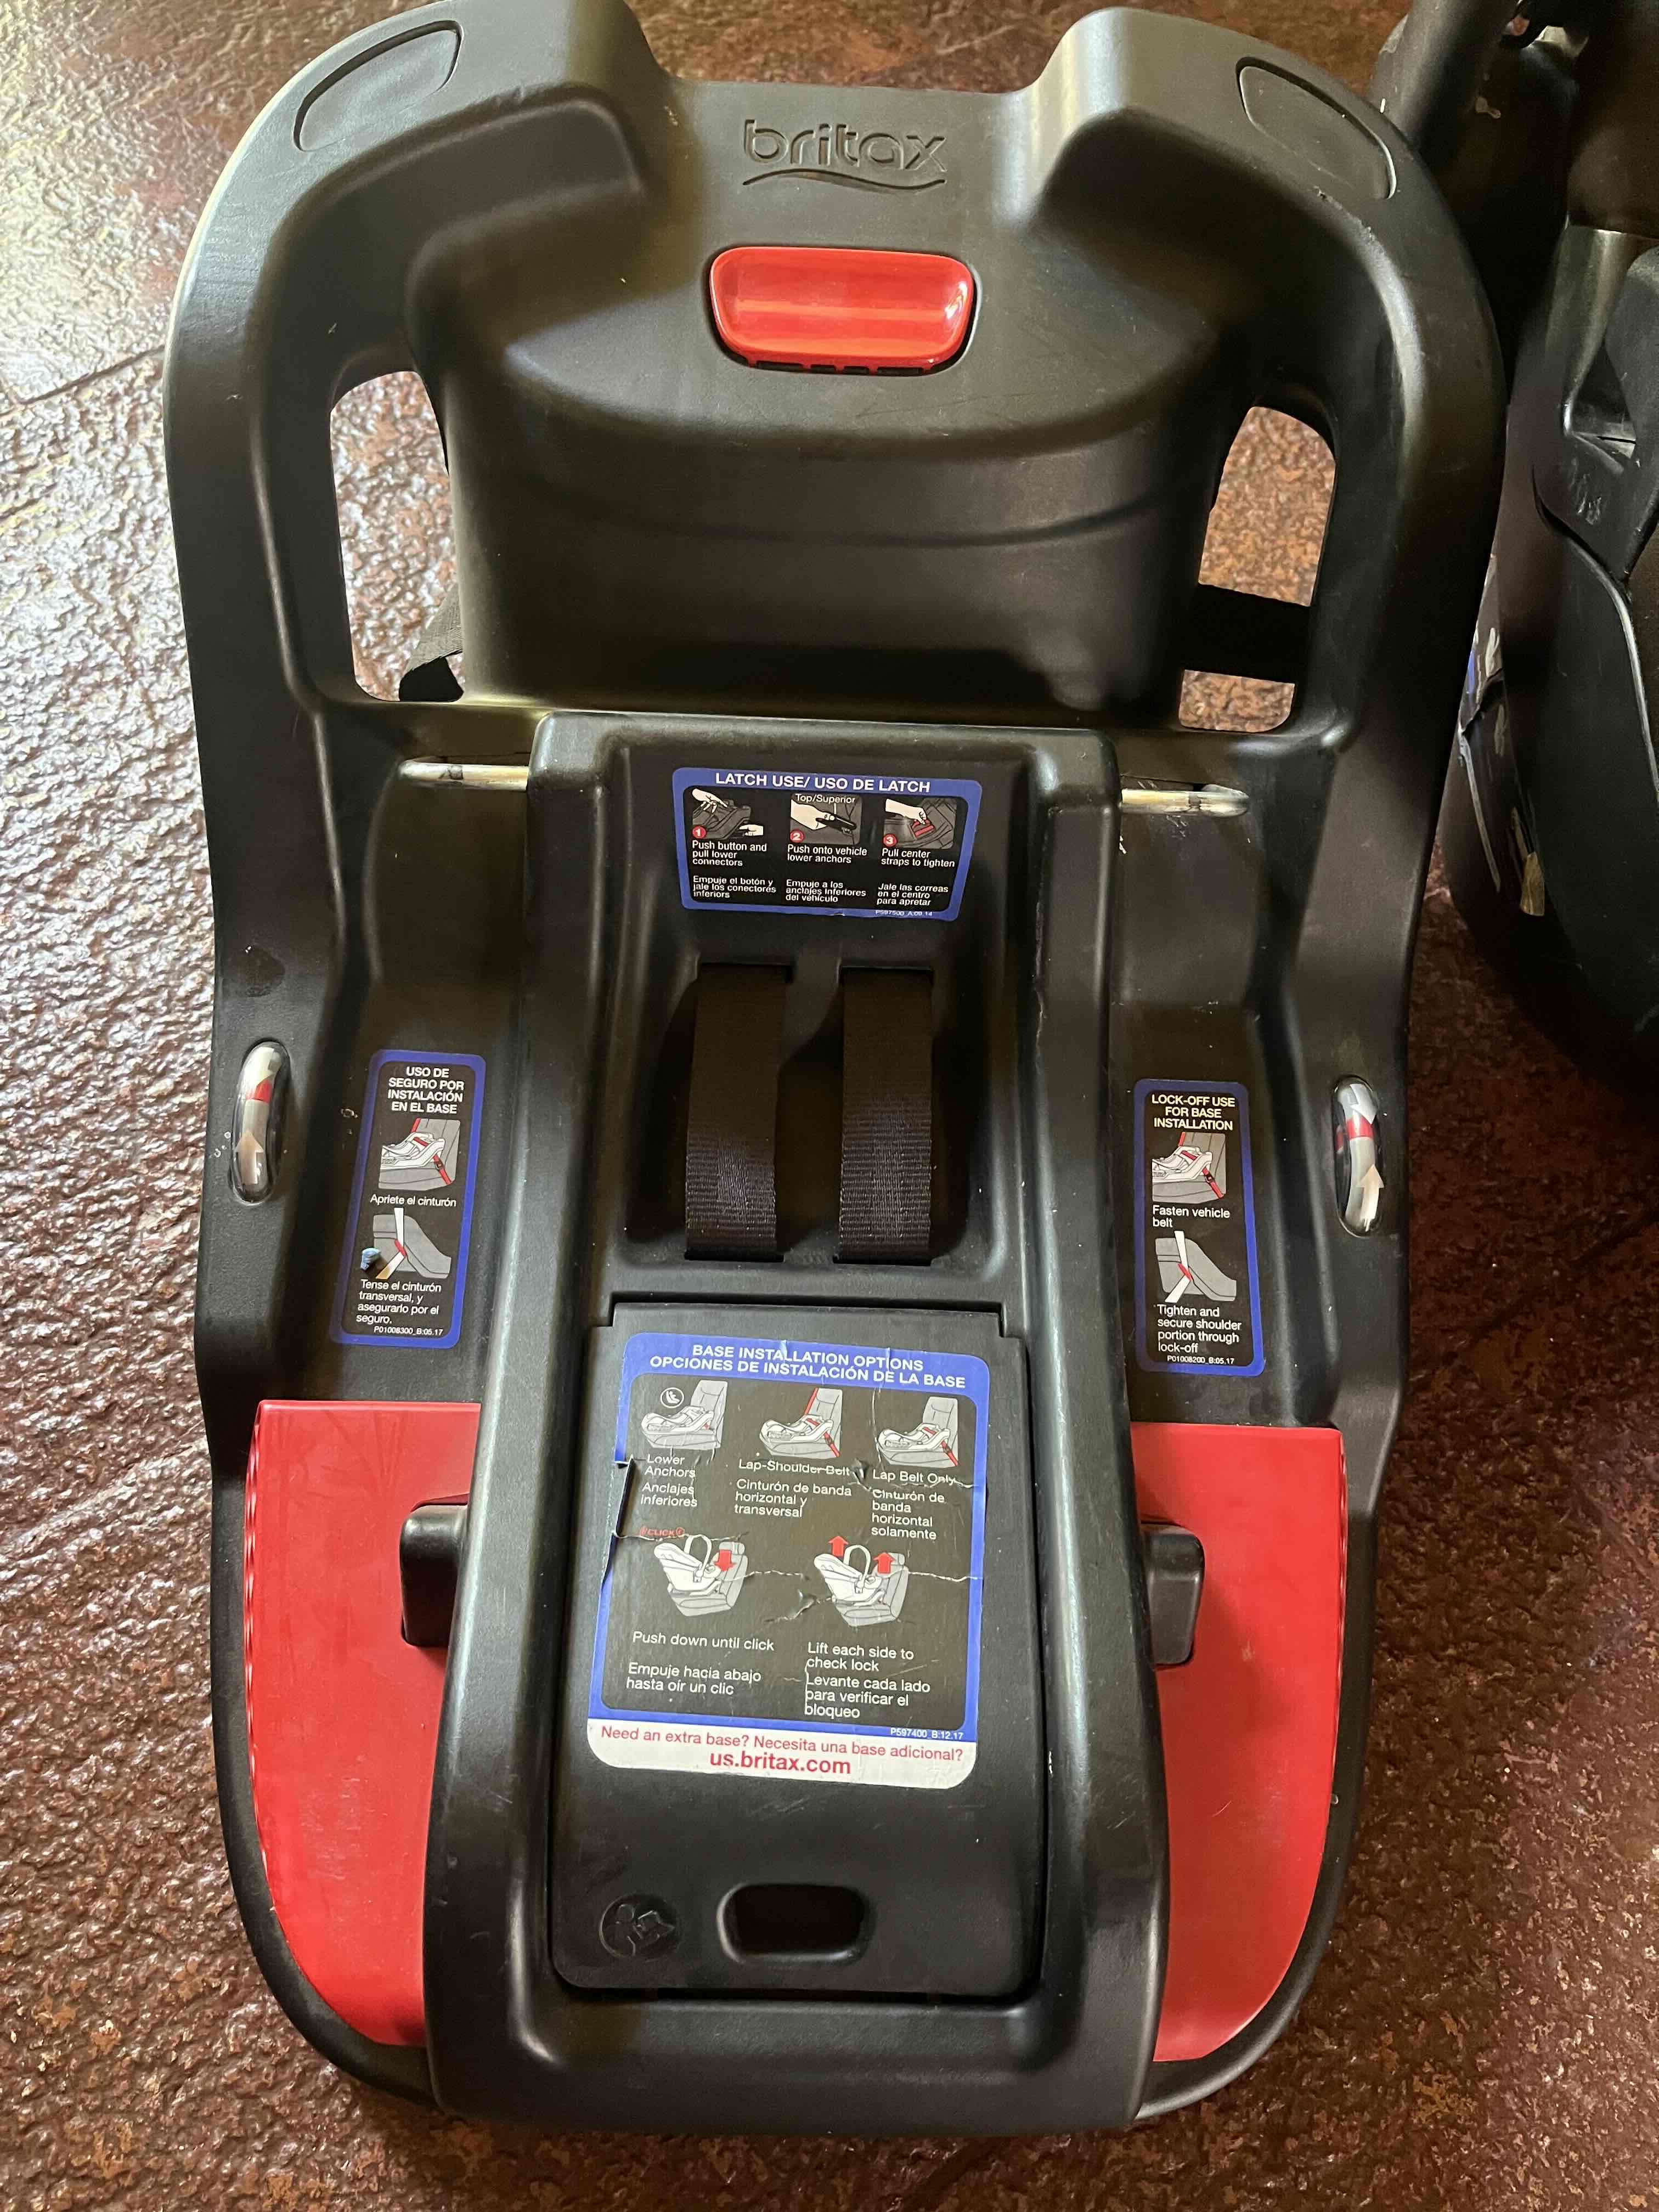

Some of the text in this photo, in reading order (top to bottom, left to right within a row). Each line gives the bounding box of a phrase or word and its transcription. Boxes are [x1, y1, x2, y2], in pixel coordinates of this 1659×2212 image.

[743, 119, 947, 172] britax
[716, 772, 930, 792] LATCH USE/ USO DE LATCH
[795, 794, 855, 804] Top/Superior
[692, 840, 767, 851] Push button and
[787, 844, 867, 856] Push onto vehicle
[882, 848, 899, 857] Pull
[815, 855, 851, 864] anchors
[881, 857, 909, 866] straps
[924, 859, 955, 867] tighten
[693, 876, 727, 884] Empuje
[786, 879, 819, 888] Empuje
[786, 887, 822, 895] anclajes
[406, 1066, 449, 1078] USO DE
[388, 1077, 464, 1090] SEGURO POR
[387, 1089, 463, 1102] INSTALACIÓN
[1152, 1094, 1235, 1107] LOCK-OFF USE
[392, 1102, 457, 1114] EN EL BASE
[1165, 1107, 1222, 1118] FOR BASE
[1154, 1118, 1233, 1130] INSTALLATION
[370, 1194, 456, 1207] Apriete el cinturón
[1153, 1205, 1230, 1218] Fasten vehicle
[1153, 1217, 1173, 1227] belt
[360, 1279, 441, 1292] Tense el cinturón
[359, 1291, 423, 1304] transversal, y
[358, 1303, 439, 1316] asegurarlo por el
[1157, 1305, 1220, 1317] Tighten and
[356, 1314, 392, 1324] seguro.
[1158, 1318, 1242, 1330] secure shoulder
[1158, 1330, 1239, 1345] portion through
[1158, 1342, 1198, 1352] lock-off
[692, 1345, 924, 1371] BASE INSTALLATION OPTIONS
[650, 1356, 966, 1388] OPCIONES DE INSTALACIÓN DE LA BASE
[647, 1454, 685, 1464] Lower
[645, 1465, 696, 1477] Anchors
[738, 1459, 850, 1476] Lap-Shoulder Belt
[873, 1469, 955, 1485] Lap Belt Only
[642, 1482, 695, 1496] Anclajes
[737, 1479, 851, 1496] Cinturón de banda
[735, 1491, 808, 1506] horizontal y
[872, 1489, 945, 1503] Cinturón de
[735, 1504, 803, 1517] transversal
[872, 1500, 911, 1513] banda
[872, 1513, 933, 1527] horizontal
[871, 1526, 936, 1539] solamente
[633, 1630, 774, 1651] Push down until click
[808, 1642, 914, 1660] Lift each side to
[807, 1657, 879, 1672] check lock
[629, 1662, 761, 1684] Empuje hacia abajo
[627, 1677, 734, 1695] hasta oír un clic
[806, 1675, 930, 1692] Levante cada lado
[806, 1690, 909, 1706] para verificar el
[805, 1703, 860, 1719] bloqueo
[601, 1726, 963, 1761] Need an extra base? Necesita una base adicional?
[710, 1751, 851, 1774] us.britax.com
